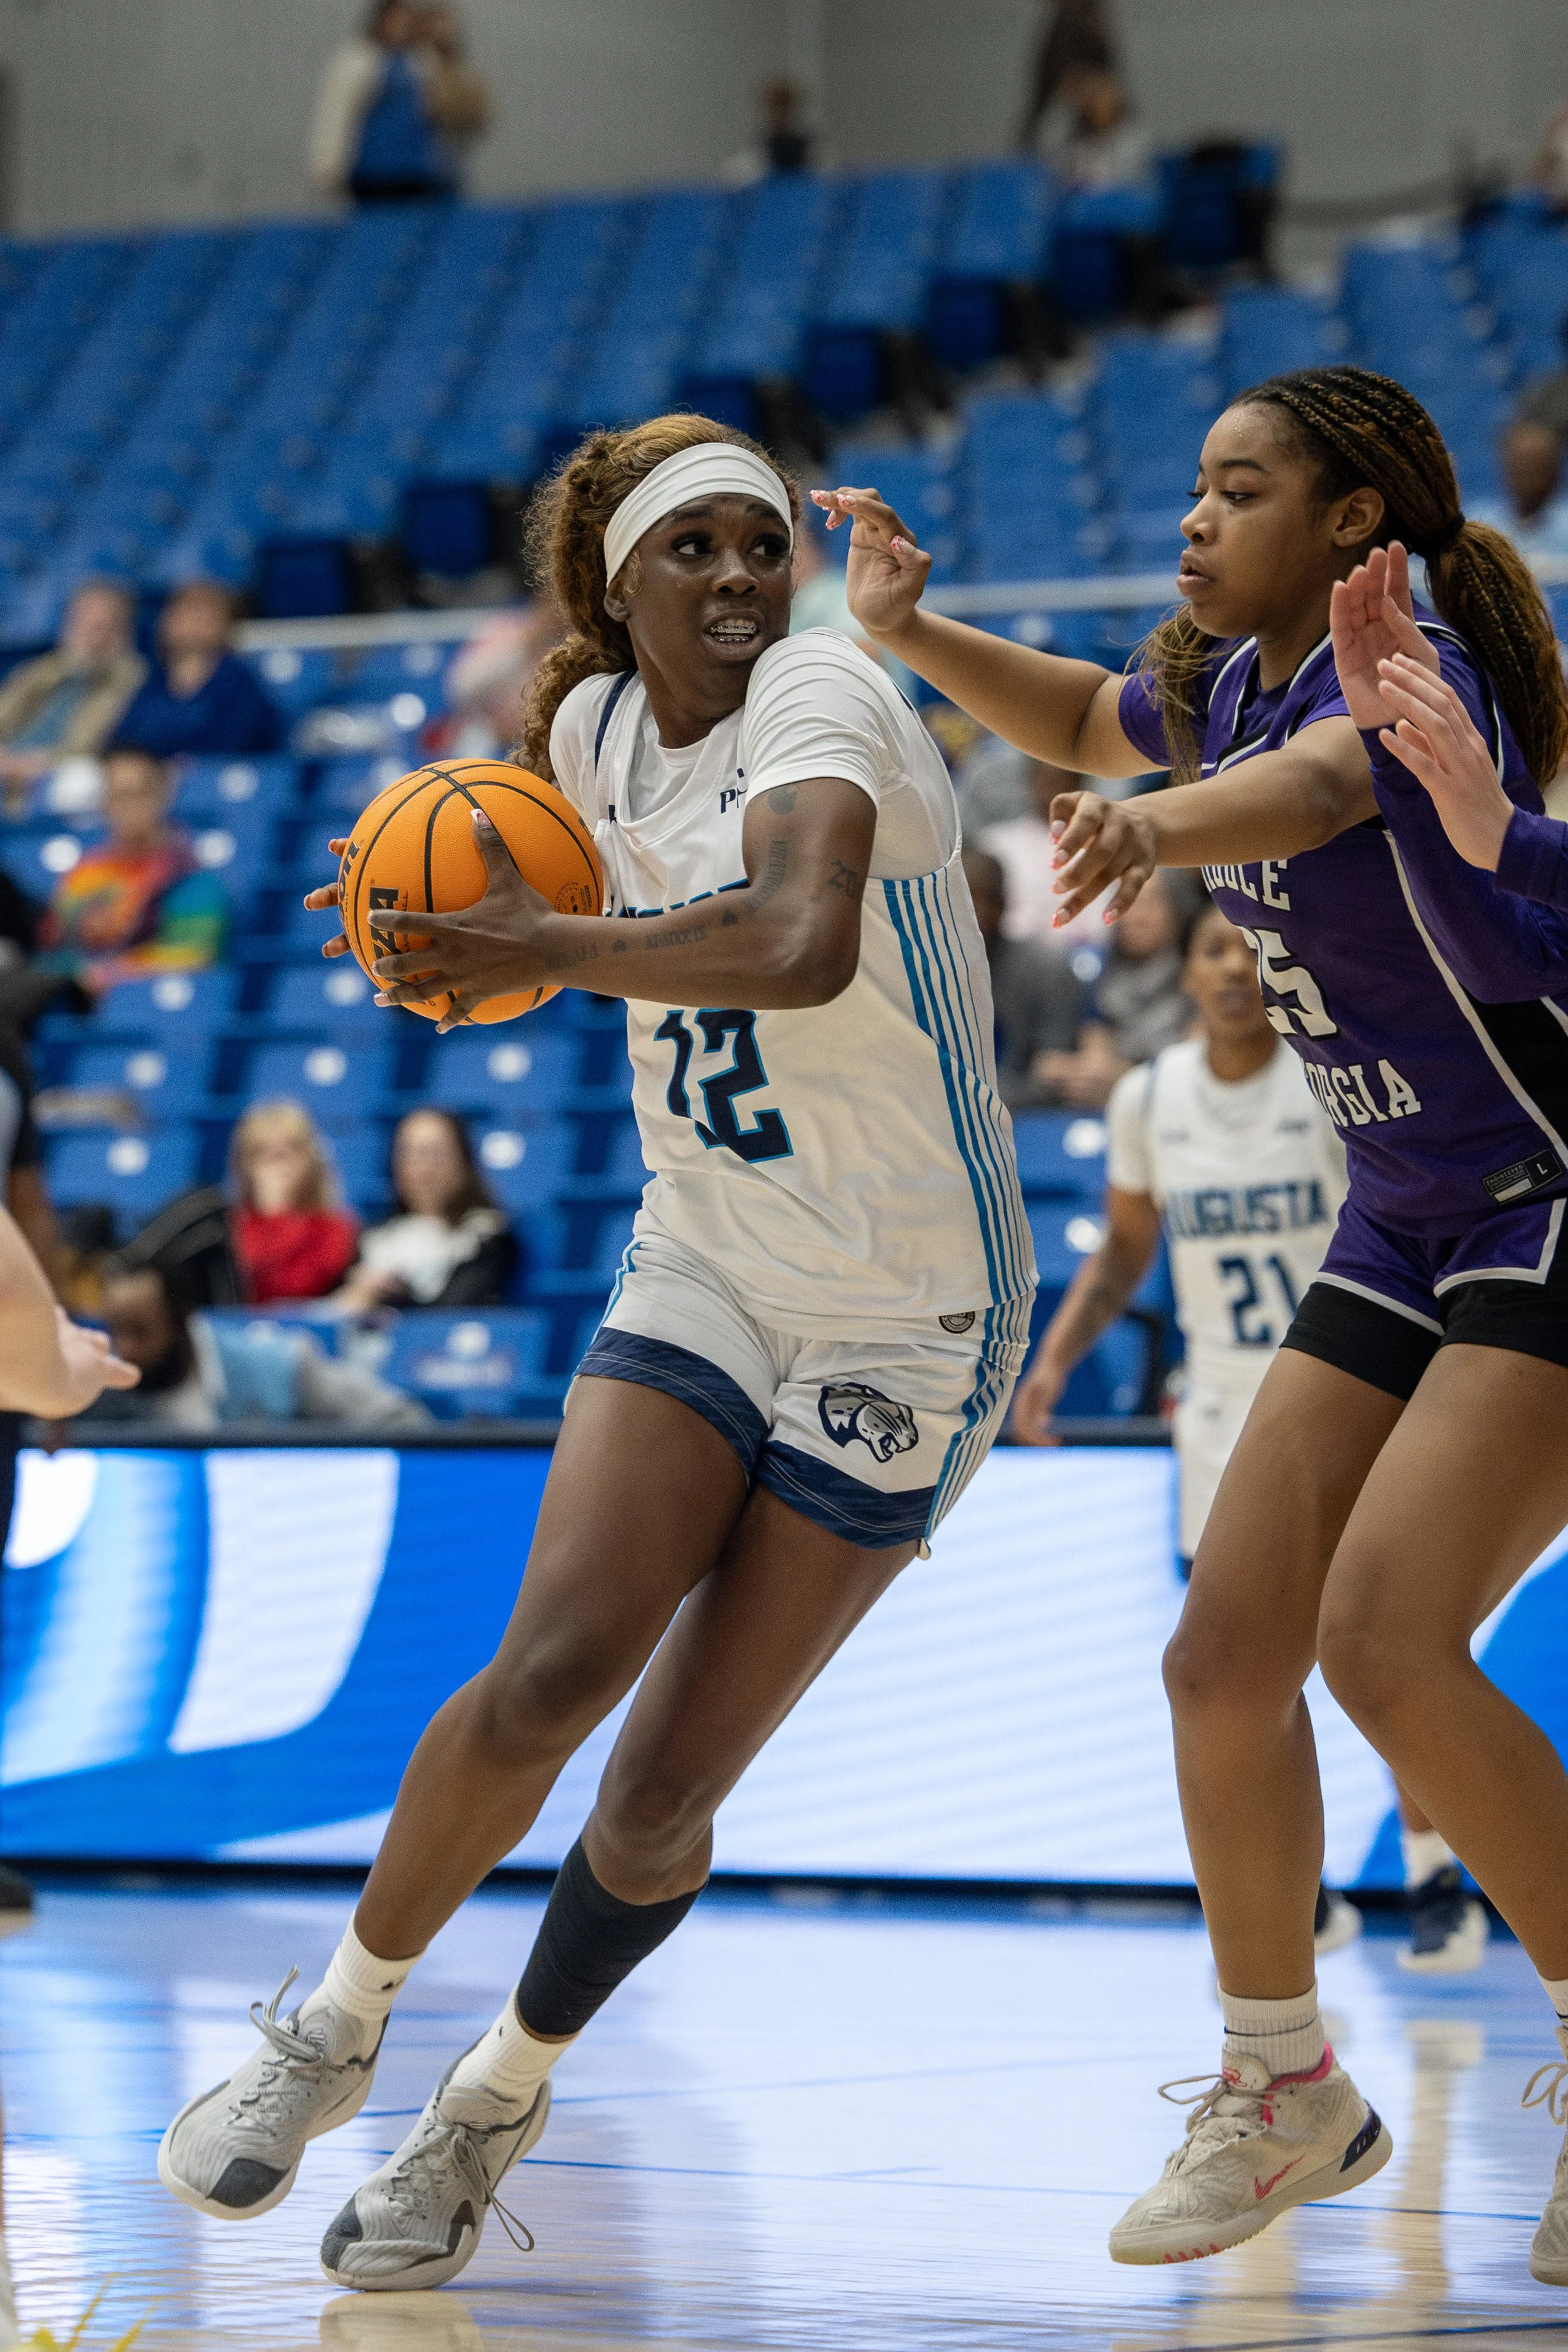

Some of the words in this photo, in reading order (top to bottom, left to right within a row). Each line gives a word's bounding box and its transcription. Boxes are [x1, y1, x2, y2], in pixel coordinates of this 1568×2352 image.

[654, 1009, 794, 1164] 12
[1536, 1163, 1548, 1175] L
[1217, 1252, 1300, 1346] 21
